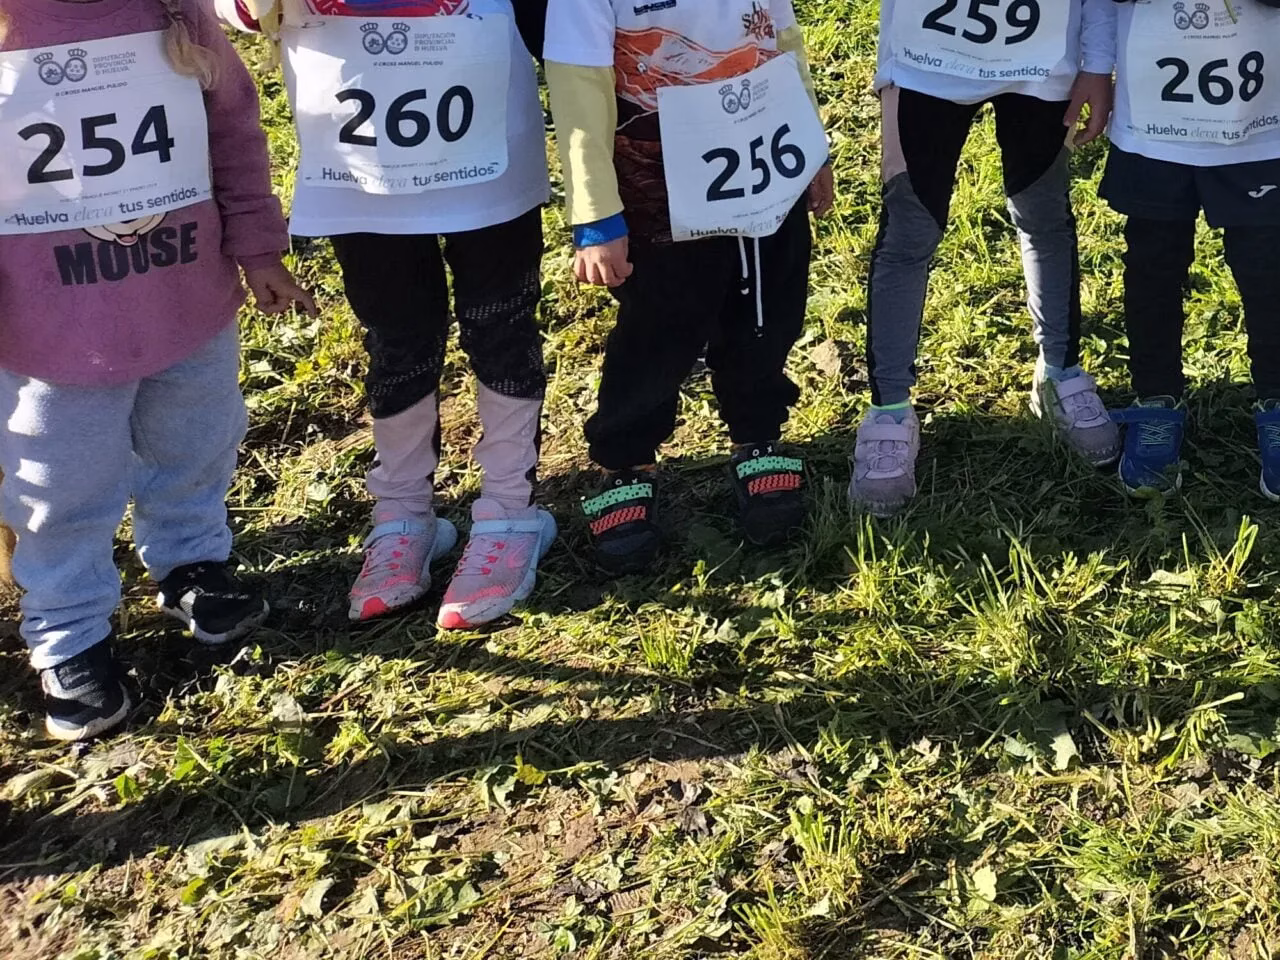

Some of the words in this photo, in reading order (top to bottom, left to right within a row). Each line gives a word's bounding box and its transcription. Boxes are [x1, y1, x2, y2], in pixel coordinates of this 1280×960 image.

[904, 47, 942, 67] Huelva
[978, 68, 996, 79] tus
[1000, 66, 1050, 78] sentidos
[1155, 50, 1265, 105] 268
[335, 85, 474, 147] 260
[1147, 124, 1187, 136] Huelva
[1222, 130, 1240, 140] tus
[18, 104, 175, 184] 254
[701, 123, 806, 202] 256
[322, 167, 367, 185] Huelva
[434, 166, 496, 183] sentidos
[16, 210, 69, 226] Huelva
[118, 201, 144, 214] tus
[146, 186, 198, 209] sentidos
[54, 221, 198, 287] MOUSE
[690, 226, 738, 237] Huelva
